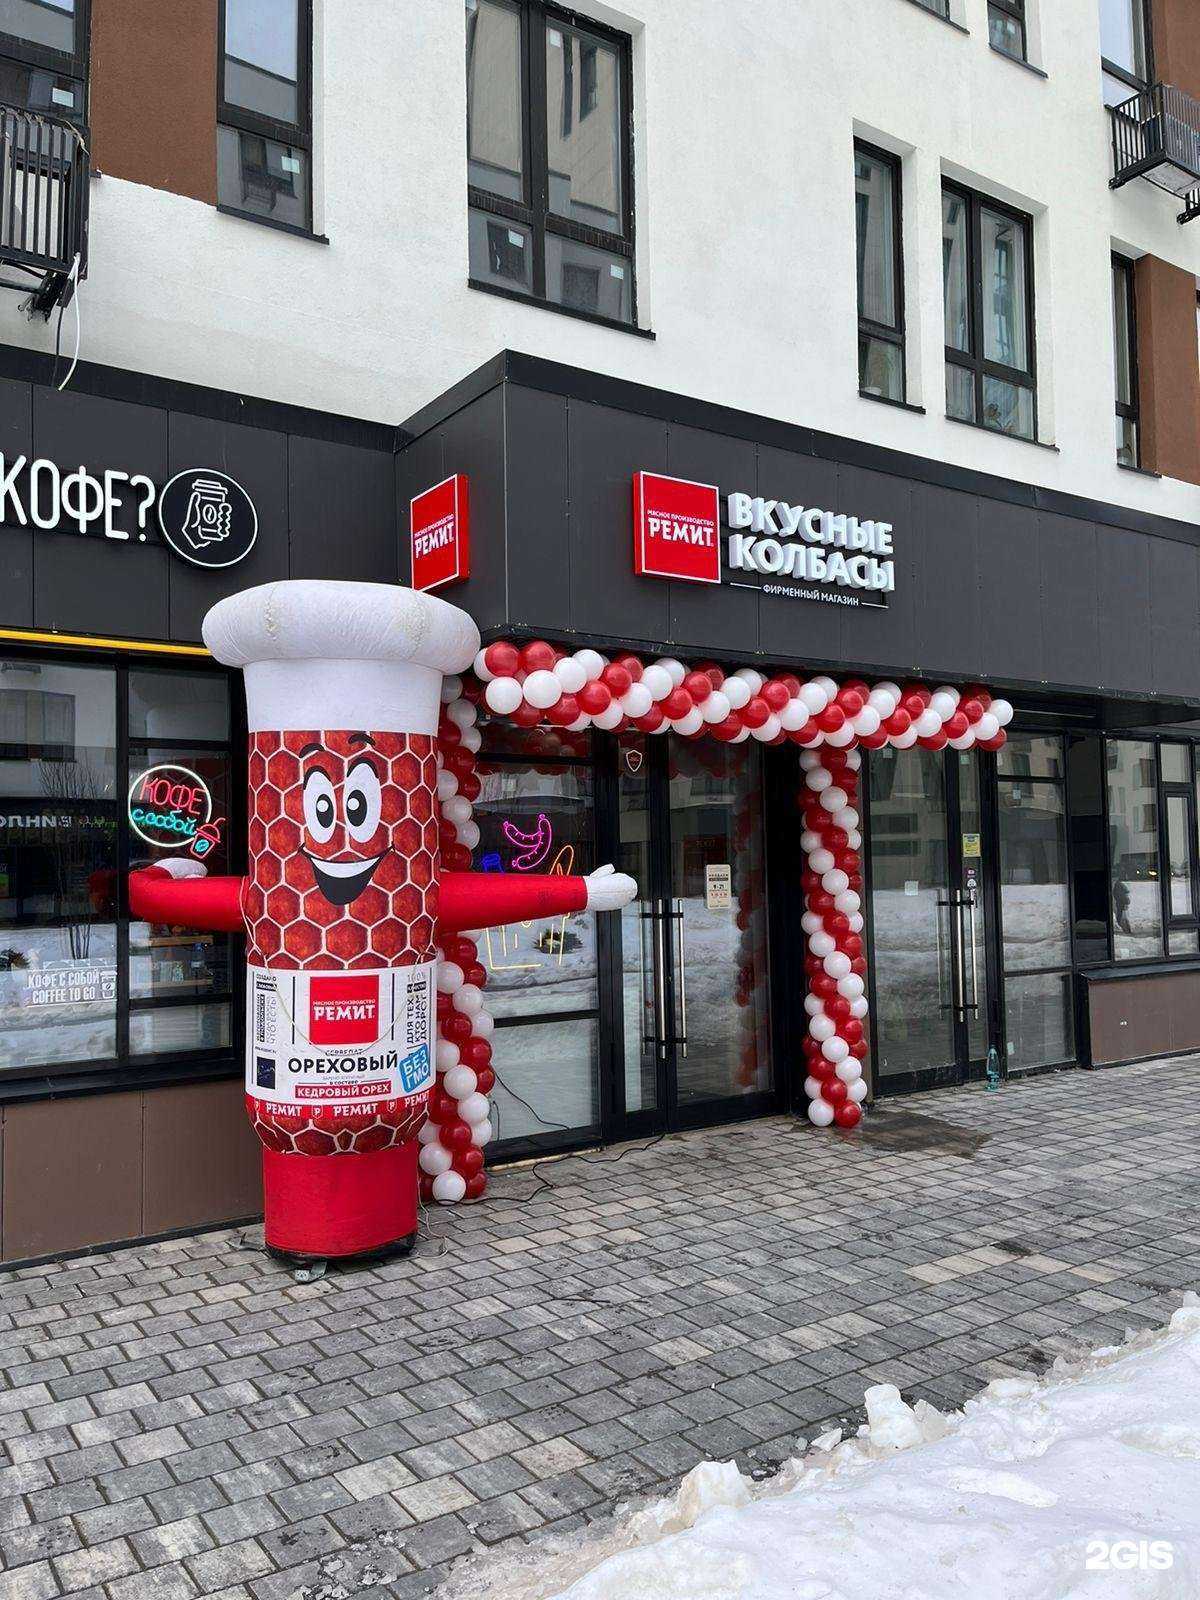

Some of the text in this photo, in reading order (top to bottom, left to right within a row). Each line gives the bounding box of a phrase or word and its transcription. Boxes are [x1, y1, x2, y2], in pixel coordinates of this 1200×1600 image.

[0, 451, 156, 542] КОФЕ?
[648, 518, 714, 547] РЕМИТ
[728, 492, 893, 555] ВКУСНЫЕ
[415, 521, 455, 558] РЕМИТ
[728, 533, 895, 592] КОЛБАСЫ
[763, 584, 859, 606] ФИРМЕННЫЙ МАГАЗИН
[140, 775, 206, 815] КОФЕ
[28, 969, 100, 988] КОФЕ С СОБОЙ
[32, 986, 95, 1004] COFFEE TO GO
[313, 1005, 375, 1021] РЕМИТ
[288, 1050, 397, 1074] ОРЕХОВЫЙ
[403, 1050, 427, 1075] БЕЗ
[406, 1063, 429, 1089] ГМО
[298, 1084, 389, 1098] КЕДРОВЫЙ ОРЕХ
[404, 1090, 430, 1107] РЕМИТ
[265, 1102, 302, 1117] РЕМИТ
[333, 1102, 379, 1117] РЕМИТ
